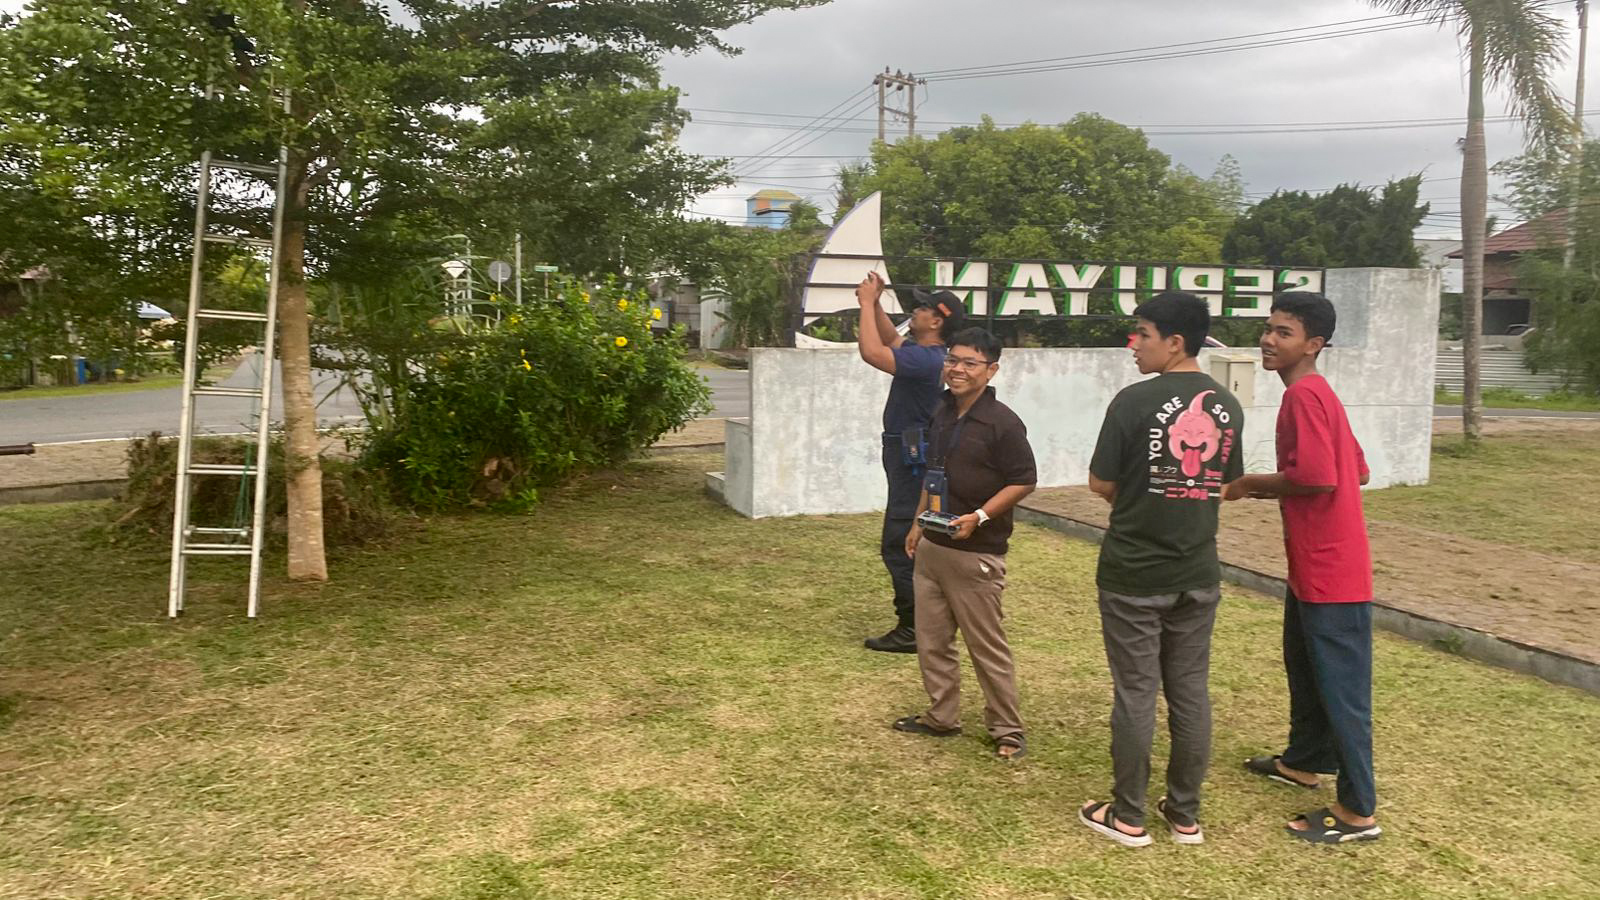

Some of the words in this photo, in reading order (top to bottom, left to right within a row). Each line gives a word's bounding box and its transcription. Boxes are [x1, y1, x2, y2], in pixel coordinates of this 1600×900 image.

[1149, 428, 1163, 460] YOU
[1156, 397, 1183, 424] ARE
[1212, 404, 1230, 423] SO
